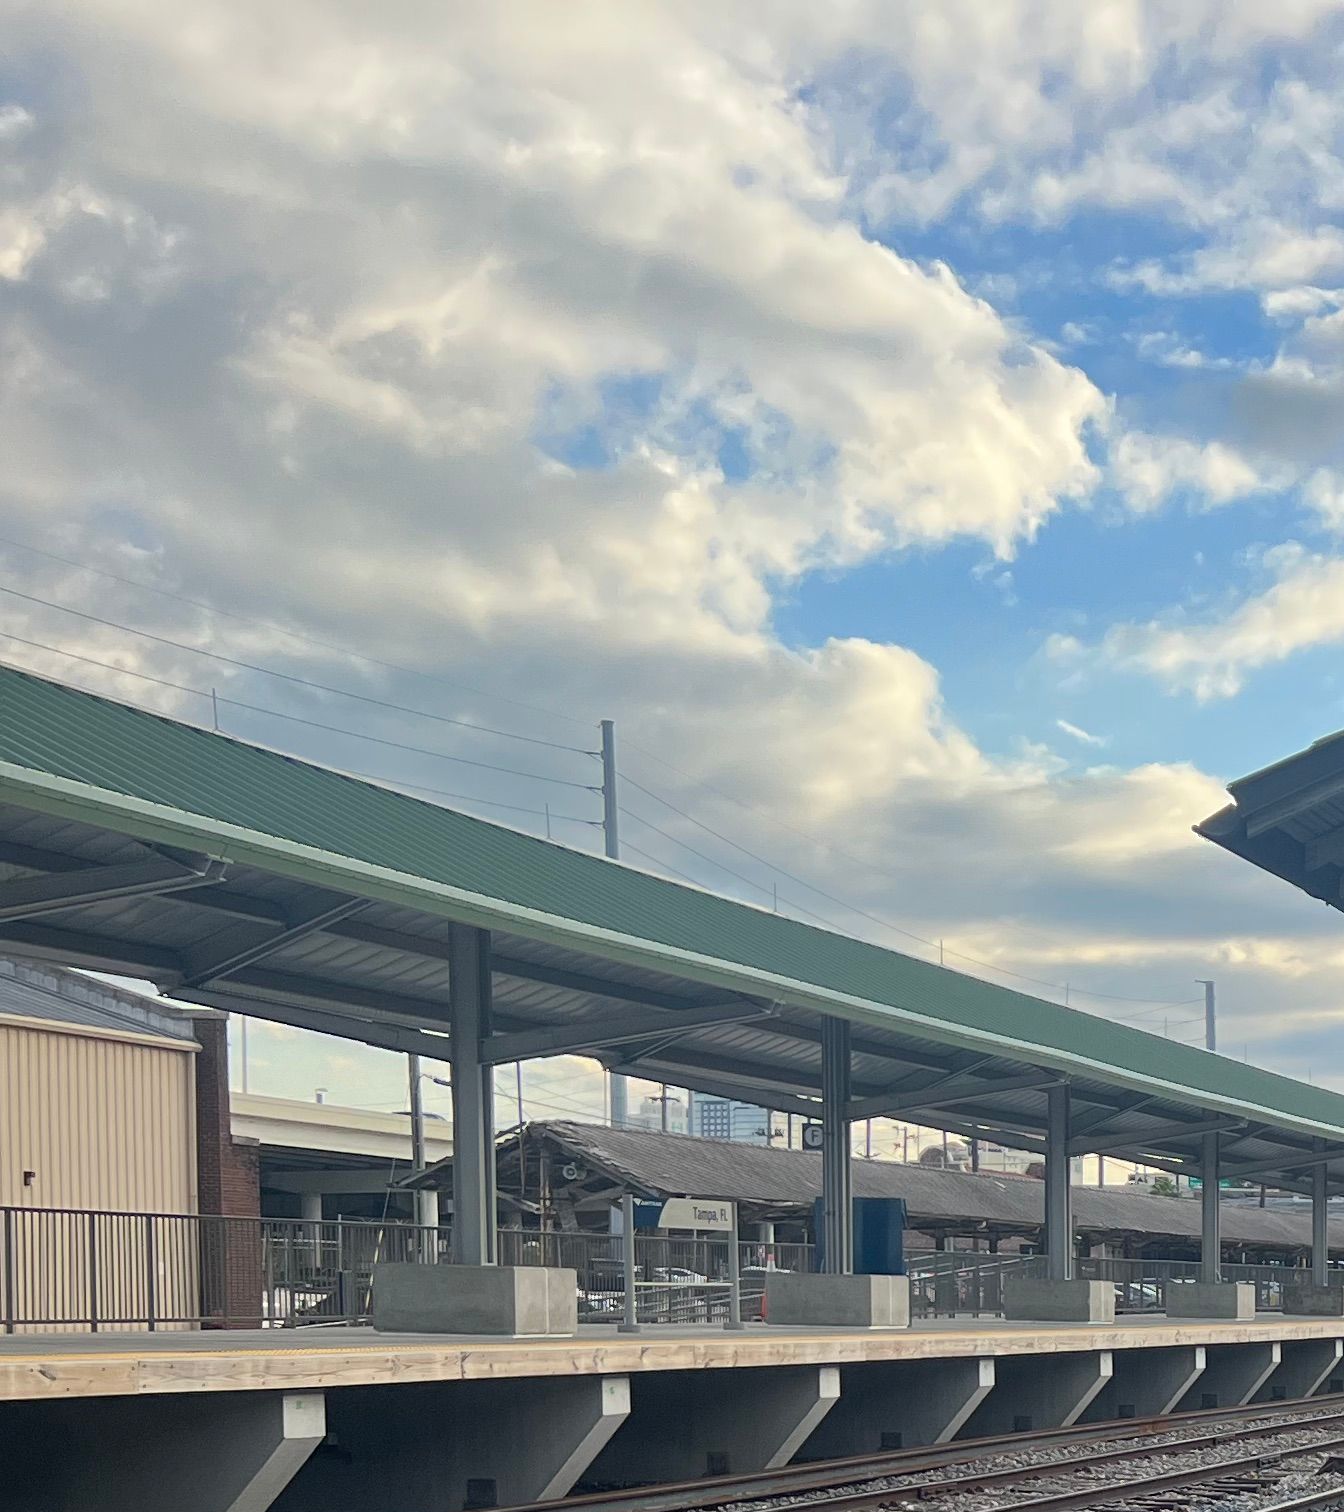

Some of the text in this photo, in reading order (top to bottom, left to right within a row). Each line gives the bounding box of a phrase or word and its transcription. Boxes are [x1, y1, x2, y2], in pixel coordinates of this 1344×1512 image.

[811, 1129, 820, 1142] F
[692, 1206, 728, 1224] Tampa, FL
